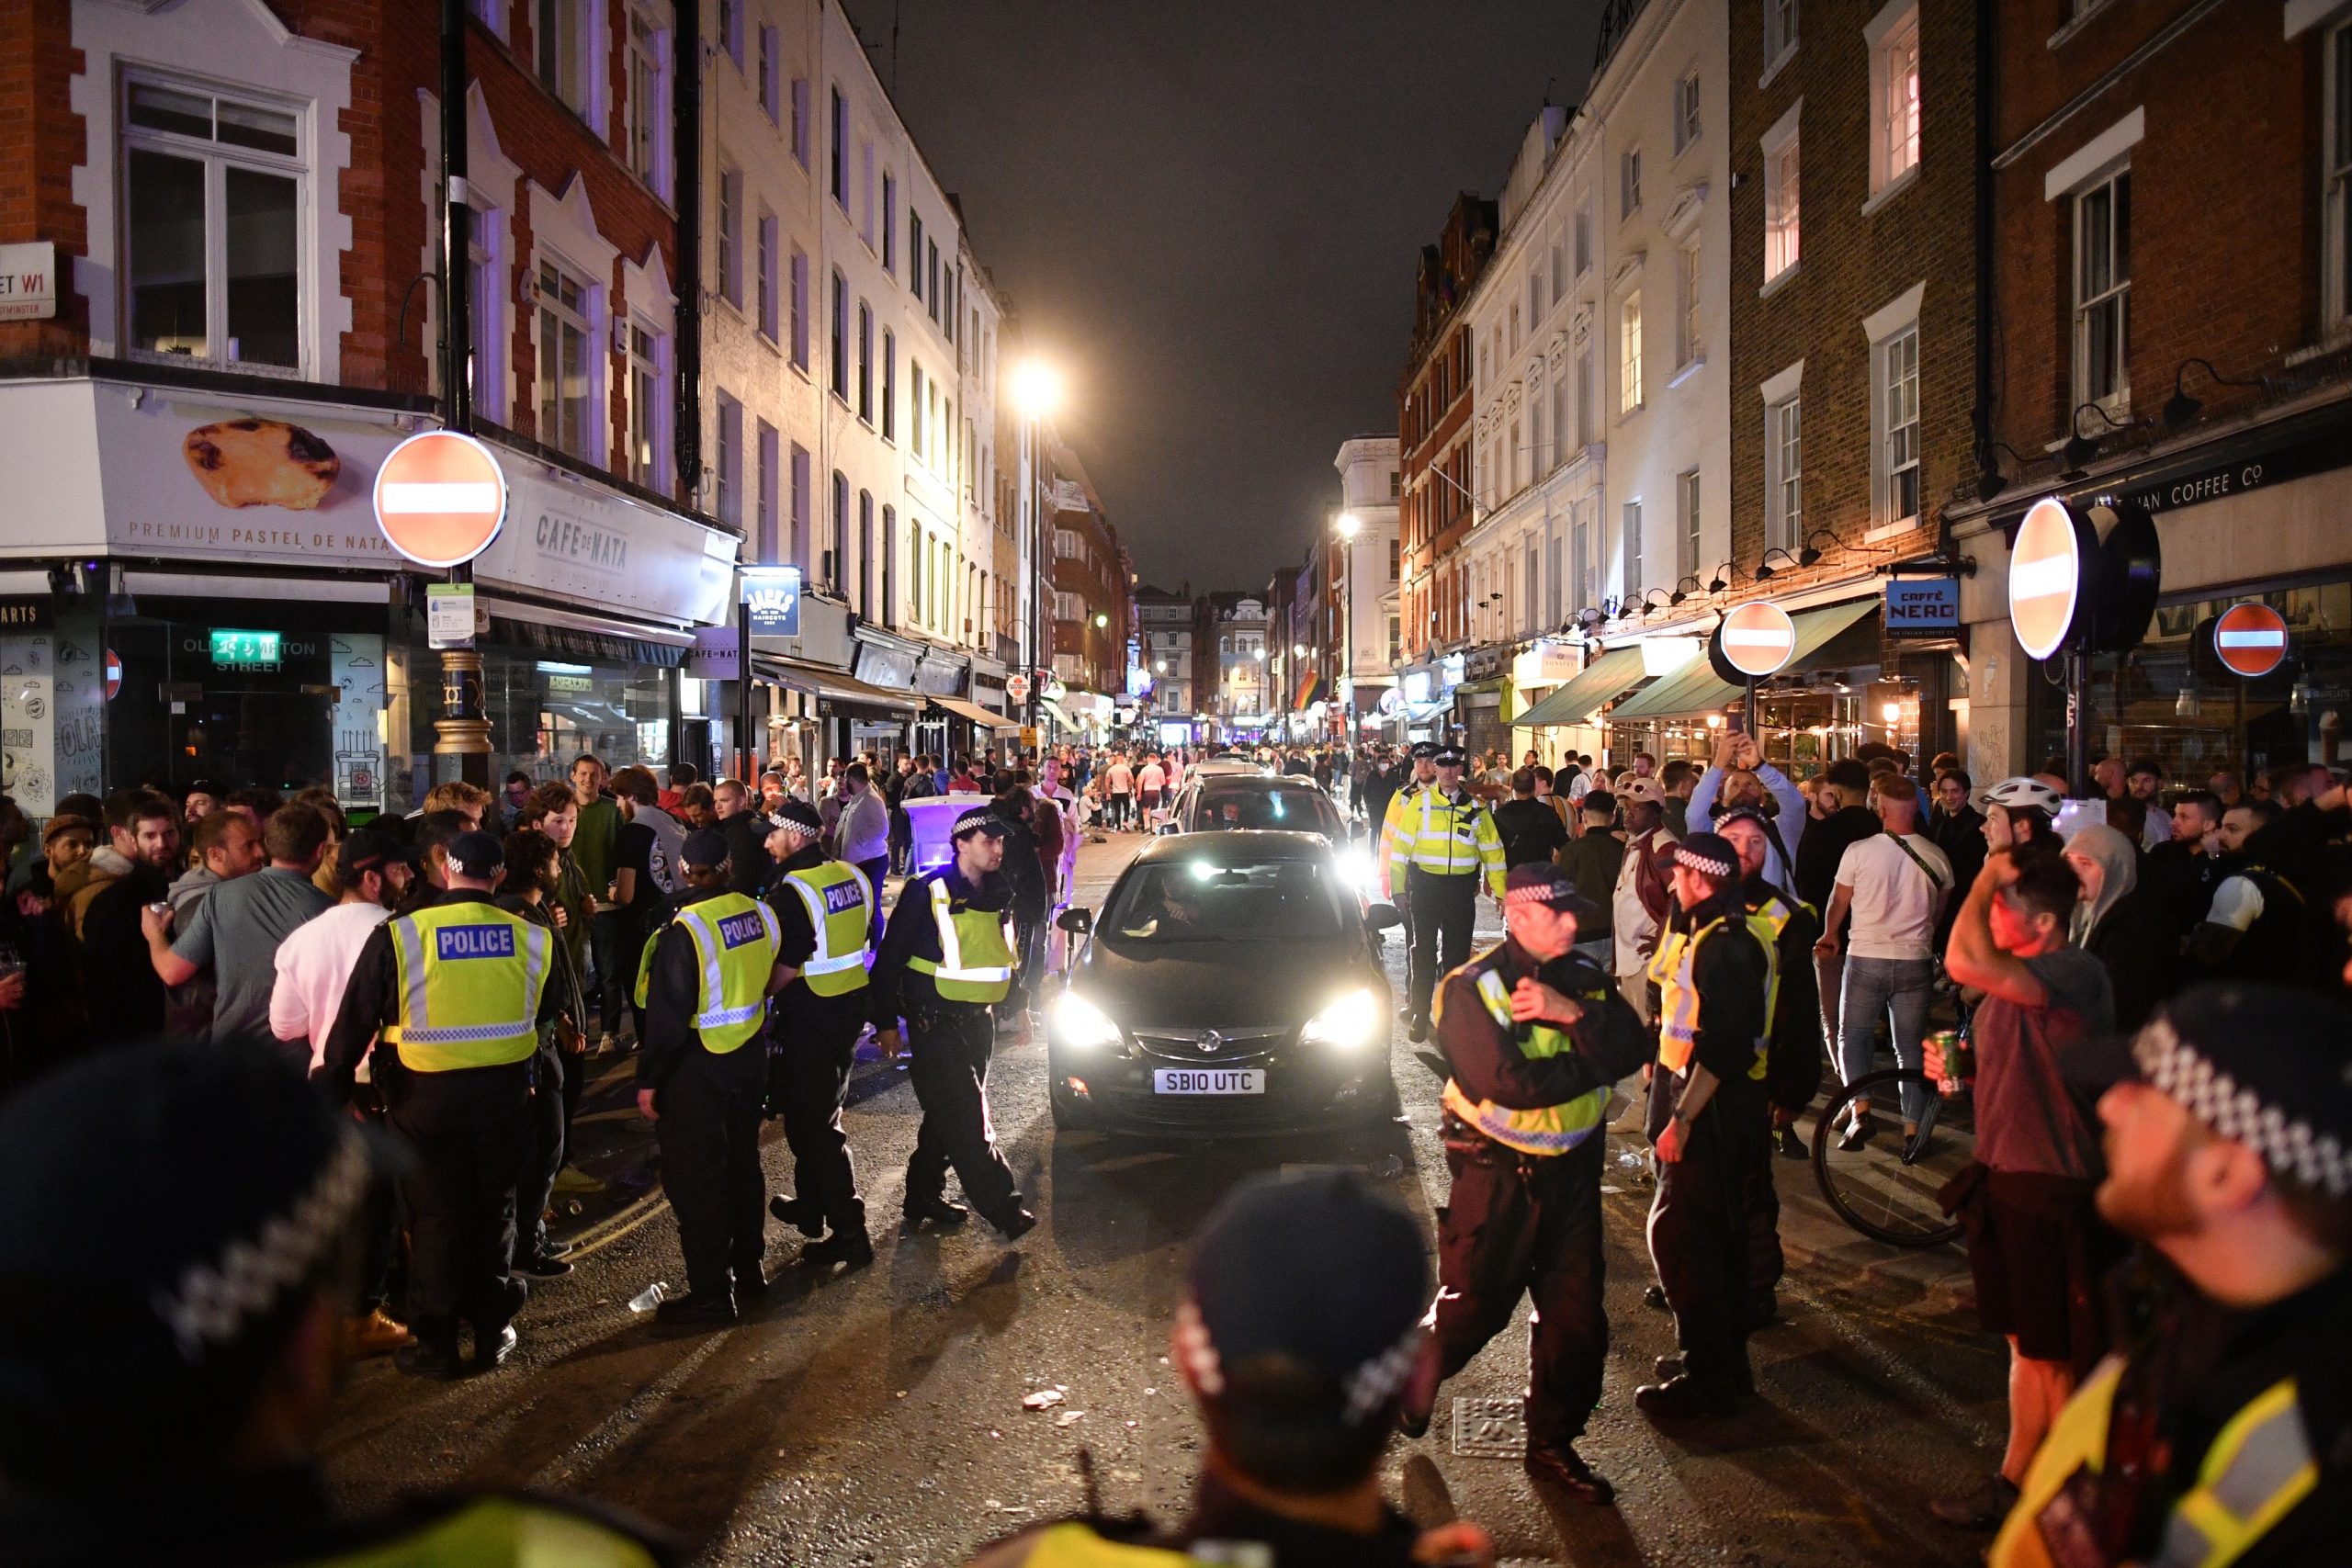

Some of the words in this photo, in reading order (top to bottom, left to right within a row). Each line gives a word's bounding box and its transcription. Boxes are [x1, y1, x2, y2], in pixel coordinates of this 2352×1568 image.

[22, 274, 44, 293] W1
[2172, 473, 2229, 504] COFFEE
[130, 522, 220, 542] PREMIUM
[232, 528, 302, 546] PASTEL
[313, 534, 334, 547] DE
[345, 536, 390, 551] NATA
[582, 535, 592, 550] DE
[591, 532, 627, 568] NATA
[1, 606, 36, 624] ARTS
[1890, 604, 1955, 619] NERO
[719, 649, 739, 658] NAT
[216, 660, 285, 672] STREET
[827, 883, 862, 909] POLICE
[721, 914, 763, 944] POLICE
[440, 930, 511, 955] POLICE
[1166, 1073, 1209, 1091] SB10
[1215, 1073, 1252, 1091] UTC
